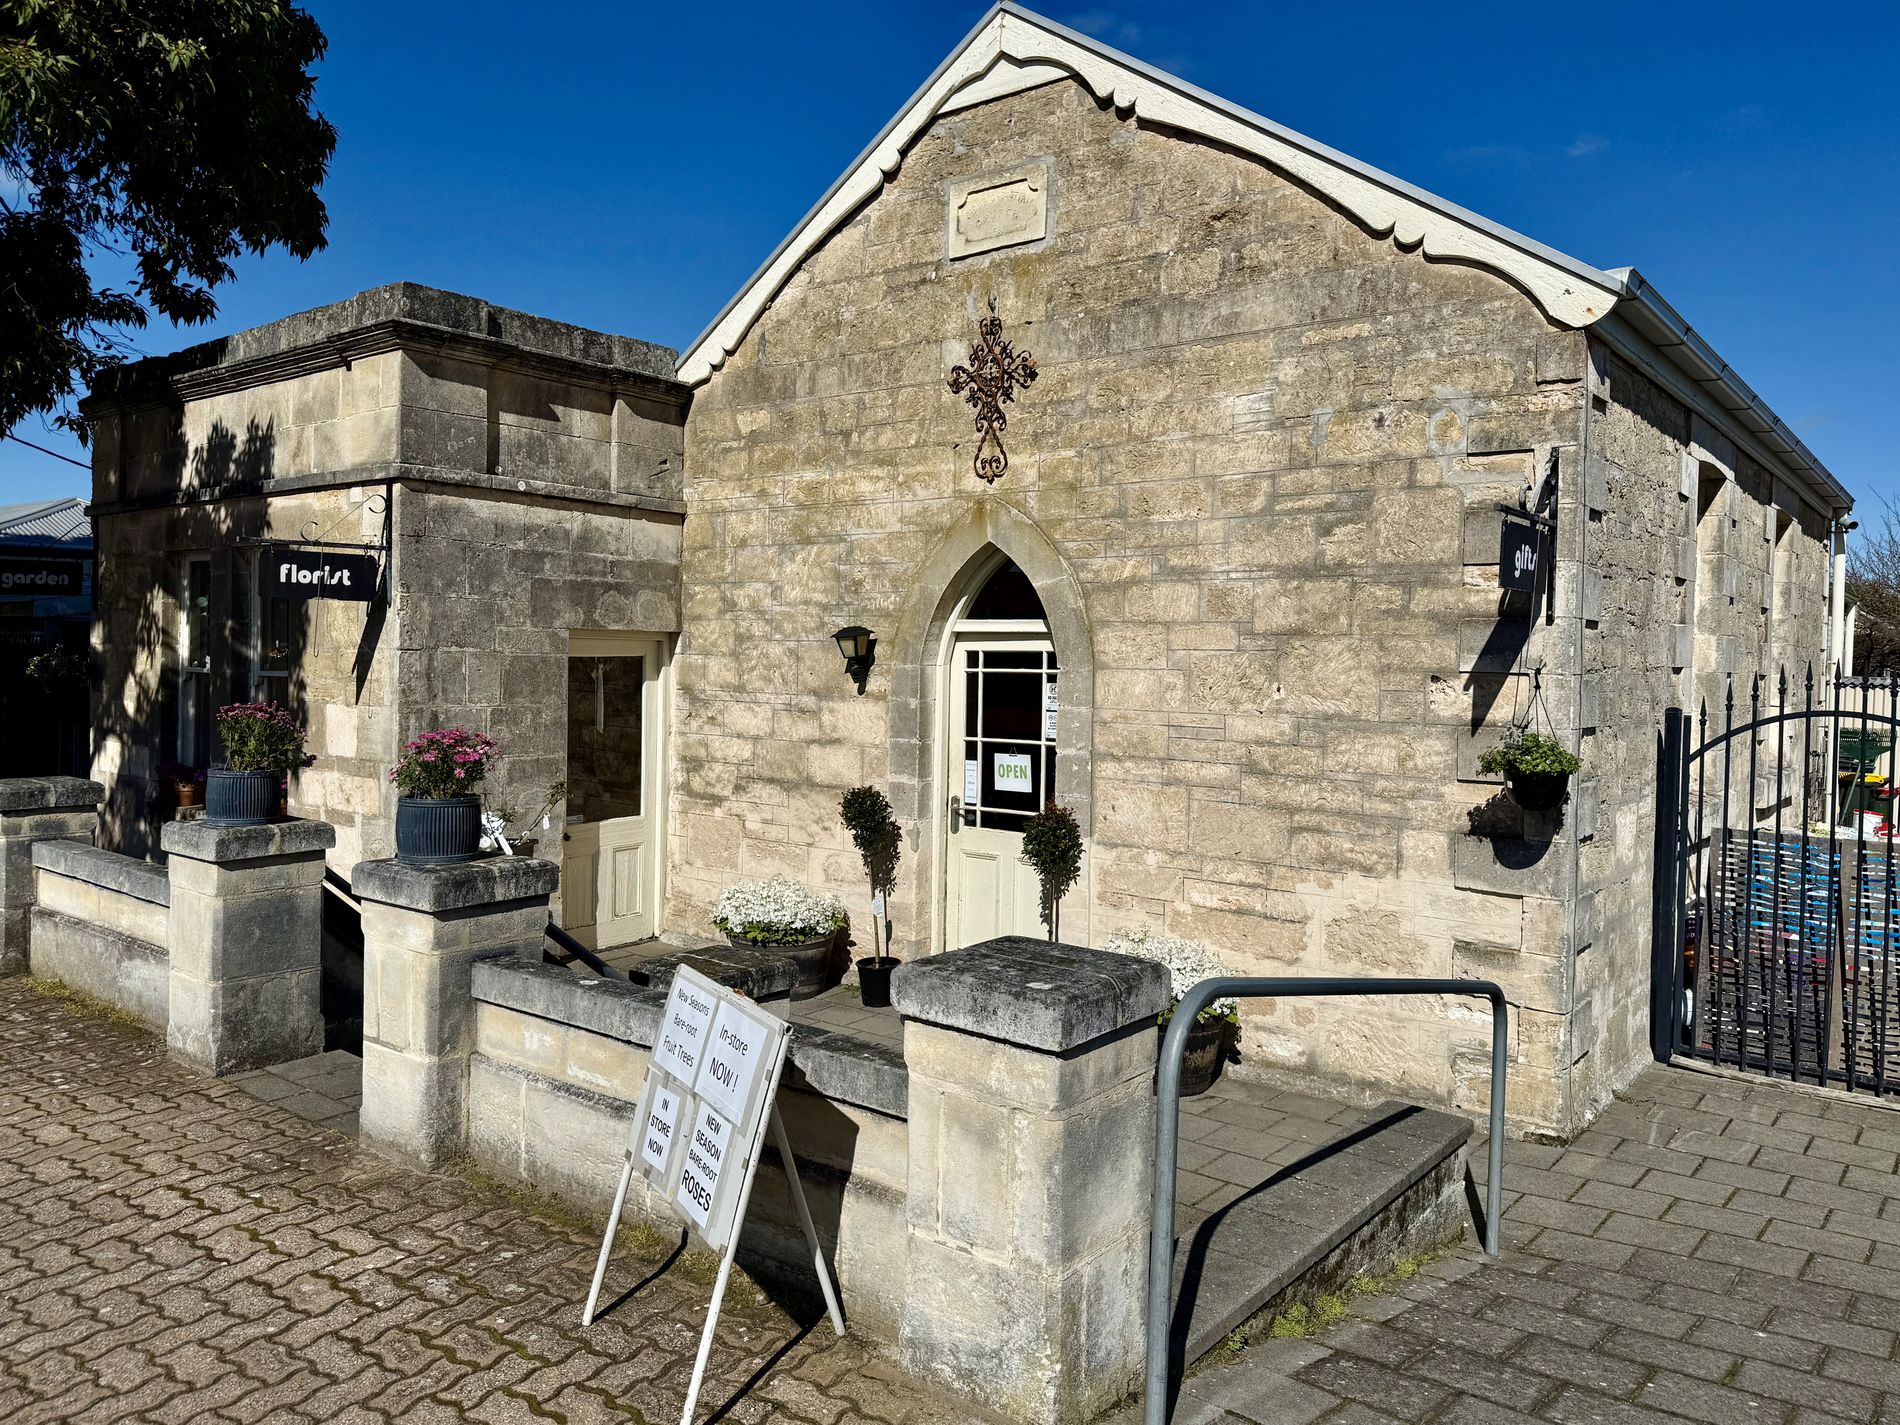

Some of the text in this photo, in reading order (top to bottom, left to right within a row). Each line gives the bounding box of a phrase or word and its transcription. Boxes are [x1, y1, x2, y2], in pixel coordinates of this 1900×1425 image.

[1514, 543, 1537, 578] gifts
[1, 571, 69, 588] garden
[280, 563, 351, 586] florist
[998, 763, 1028, 780] OPEN
[676, 988, 710, 1017] New Seasons
[673, 1012, 698, 1038] Bare-root
[663, 1034, 695, 1067] Fruit Trees
[719, 1024, 748, 1056] In-store
[709, 1057, 734, 1088] NOW
[661, 1098, 670, 1112] IN
[650, 1114, 671, 1138] STORE
[705, 1113, 722, 1135] NEW
[647, 1137, 664, 1157] NOW
[695, 1129, 722, 1162] SEASON
[688, 1148, 718, 1183] BARE-ROOT
[681, 1168, 712, 1212] ROSES
